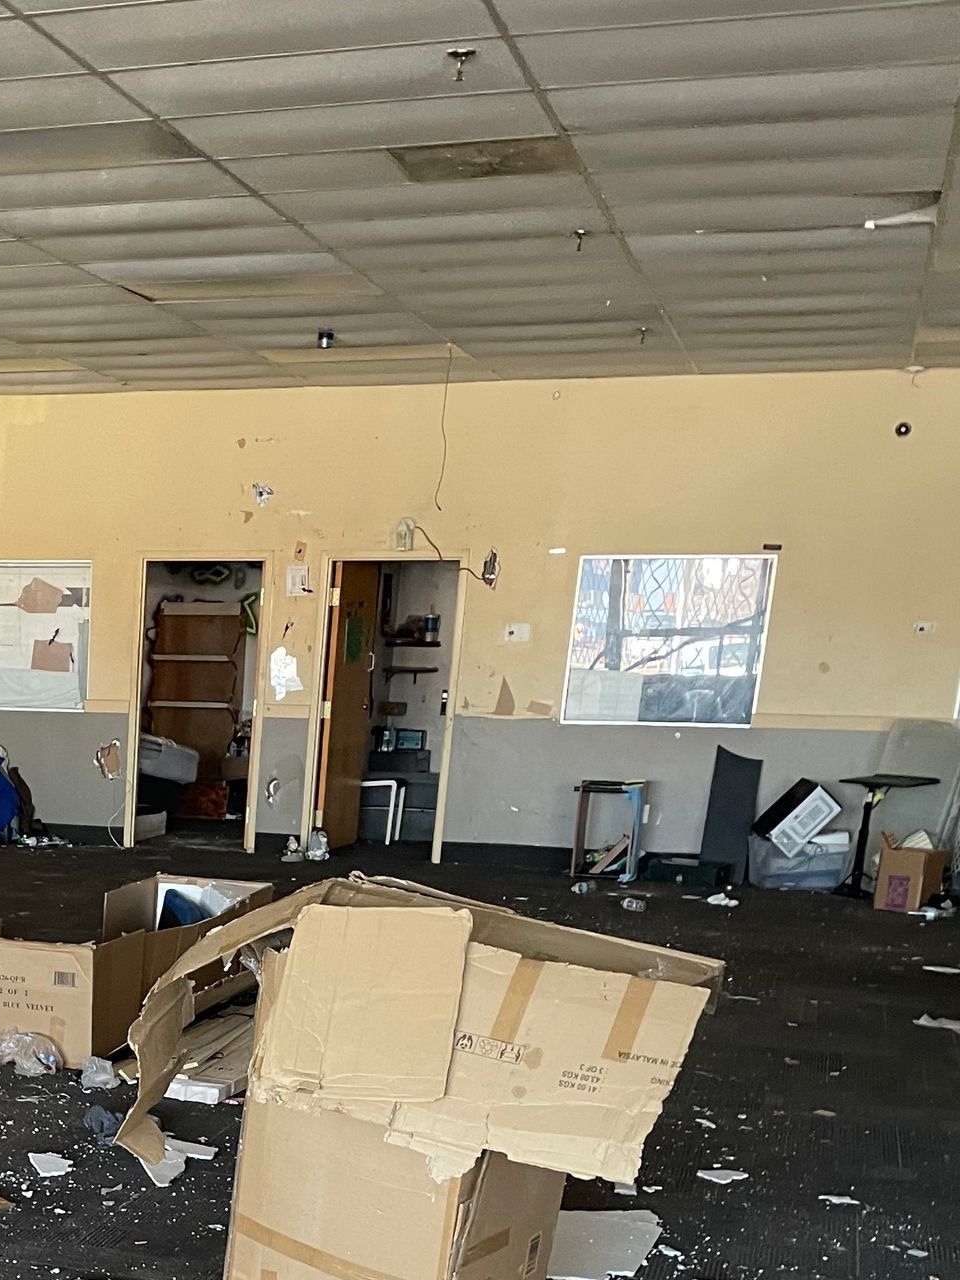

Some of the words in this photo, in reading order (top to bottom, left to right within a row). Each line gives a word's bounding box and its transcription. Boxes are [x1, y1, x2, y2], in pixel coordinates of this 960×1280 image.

[25, 1003, 54, 1012] VELVET
[618, 1050, 659, 1065] MALAYSIA
[579, 1063, 585, 1071] 3
[660, 1059, 669, 1067] IN
[586, 1065, 598, 1073] OF
[599, 1067, 604, 1075] 3
[561, 1070, 579, 1080] KGS
[558, 1080, 576, 1089] KGS
[650, 1077, 673, 1087] KING
